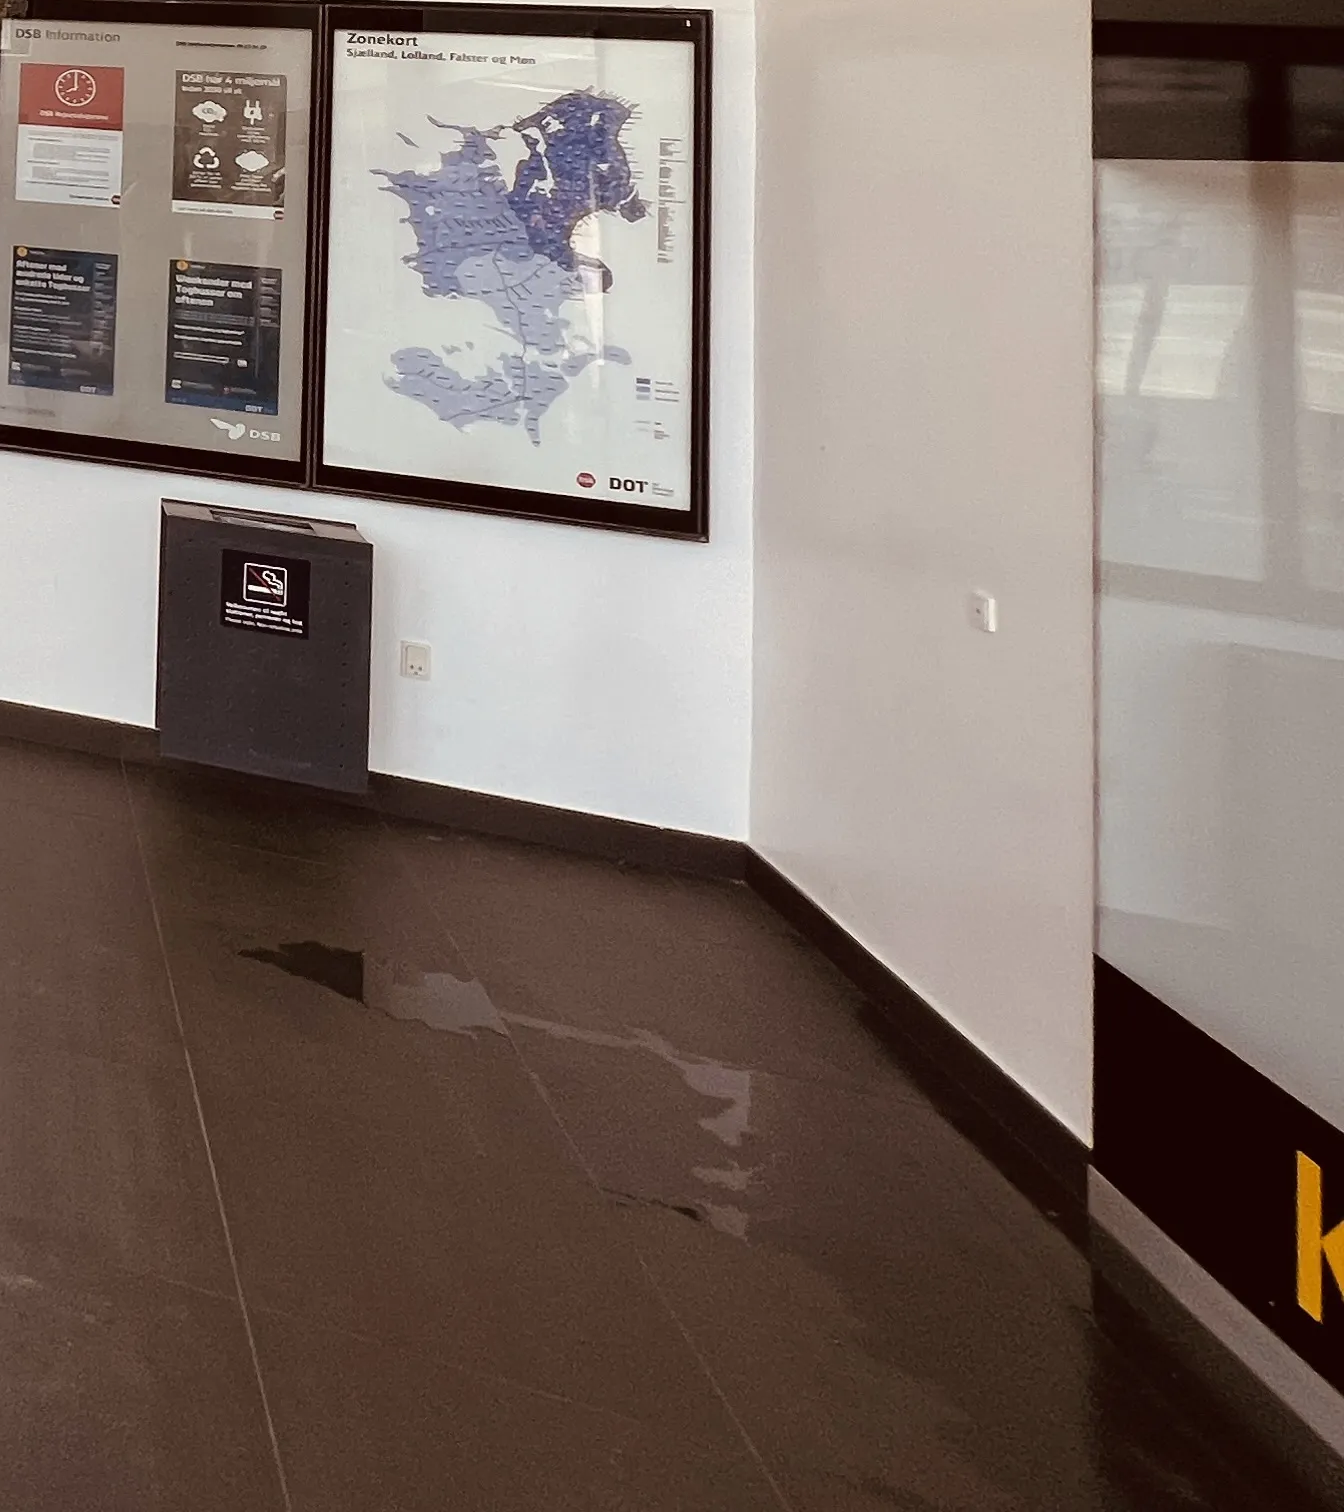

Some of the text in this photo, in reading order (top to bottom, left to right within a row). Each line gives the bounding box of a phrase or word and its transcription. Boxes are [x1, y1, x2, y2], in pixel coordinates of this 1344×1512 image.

[15, 29, 120, 42] DSB Information
[346, 32, 418, 47] Zonekort
[346, 48, 536, 65] Sjælland, Lolland, Falster og Møn
[182, 74, 203, 83] DSB
[249, 429, 280, 442] DSB
[609, 477, 649, 493] DOT
